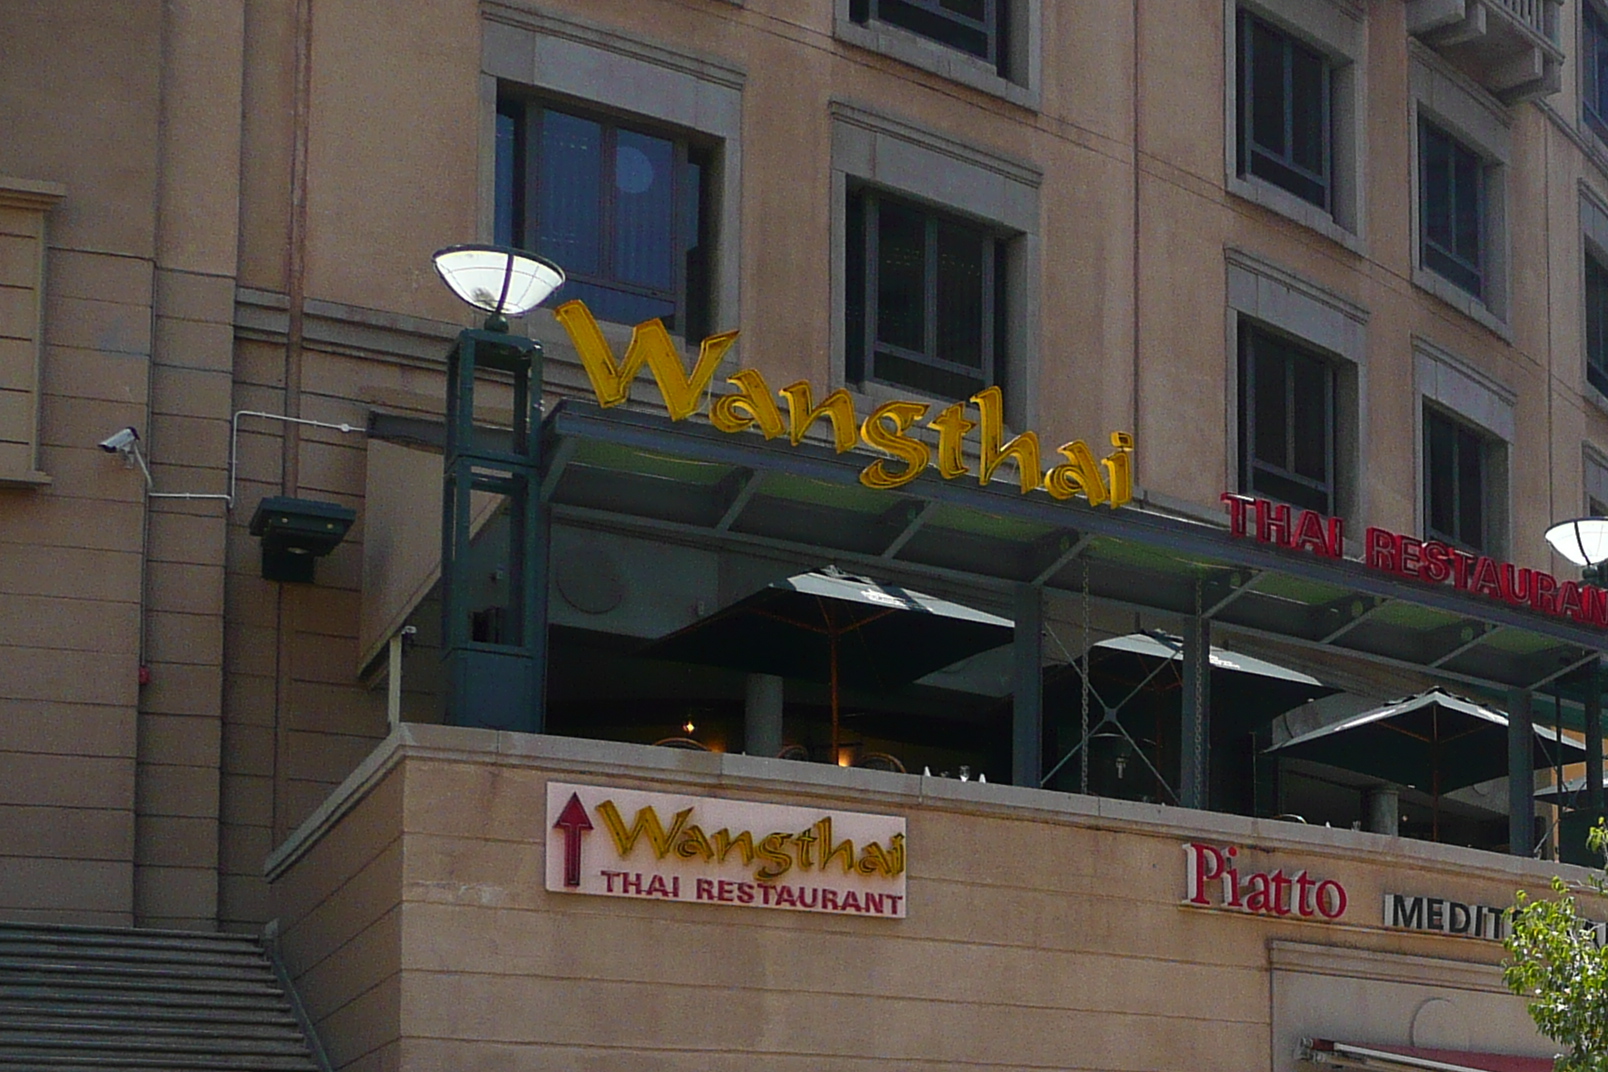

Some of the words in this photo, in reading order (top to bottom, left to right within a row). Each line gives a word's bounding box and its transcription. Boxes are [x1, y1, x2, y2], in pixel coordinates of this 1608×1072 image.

[554, 299, 1135, 509] Wangsthai
[1220, 491, 1344, 560] THAI
[595, 799, 905, 882] Wangsthai
[601, 869, 680, 898] THAI
[695, 877, 904, 916] RESTAURANT
[1186, 842, 1348, 919] Piatto
